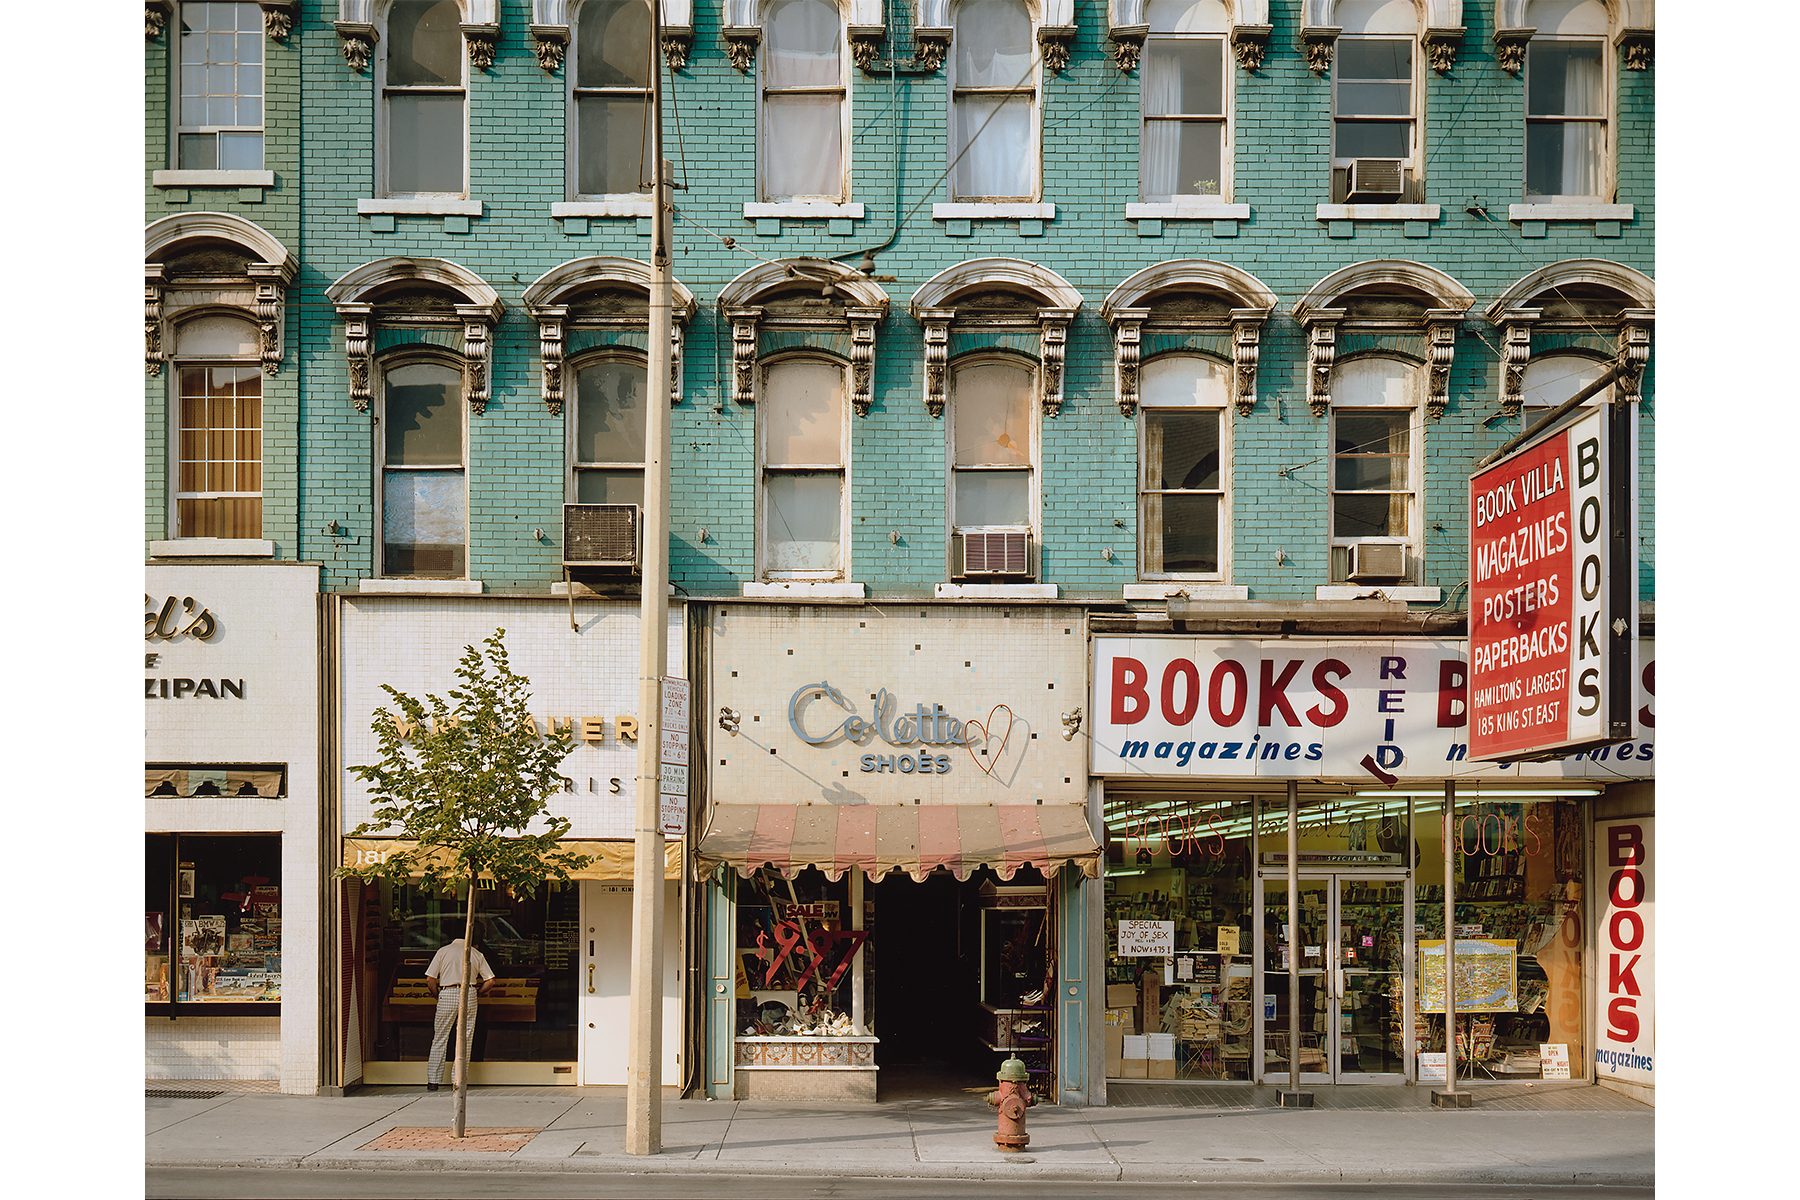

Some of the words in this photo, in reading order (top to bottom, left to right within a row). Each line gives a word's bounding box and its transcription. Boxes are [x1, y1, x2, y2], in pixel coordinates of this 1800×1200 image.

[1477, 480, 1517, 528] BOOK
[1521, 457, 1565, 507] VILLA
[1477, 511, 1567, 582] MAGAZINES
[1577, 437, 1600, 717] BOOKS
[1484, 573, 1559, 626] POSTERS
[1474, 621, 1567, 675] PAPERBACKS
[664, 691, 687, 701] LOADING
[1110, 656, 1352, 728] BOOKS
[1474, 677, 1522, 709] HAMILTON'S
[1526, 668, 1567, 697] LARGEST
[668, 700, 682, 708] ZONE
[788, 680, 978, 746] Colette
[1377, 656, 1407, 770] REID
[1478, 717, 1493, 736] 185
[1497, 710, 1518, 732] KING
[1521, 706, 1534, 728] ST.
[1536, 701, 1560, 723] EAST
[663, 741, 687, 752] STOPPING
[670, 733, 680, 742] NO
[1120, 734, 1323, 767] magazines
[664, 767, 671, 775] 30
[673, 768, 685, 776] MIN
[860, 754, 952, 774] SHOES
[663, 775, 685, 785] PARKING
[661, 805, 686, 815] STOPPING
[669, 797, 678, 806] NO
[1125, 813, 1224, 856] BOOKS
[357, 850, 385, 864] 181
[787, 904, 824, 917] SALE
[199, 920, 214, 928] BMW
[1129, 921, 1162, 929] SPECIAL
[1607, 824, 1646, 1043] BOOKS
[1121, 931, 1136, 939] JOY
[1139, 931, 1149, 939] OF
[1152, 931, 1168, 939] SEX
[1131, 945, 1150, 953] NOW
[1595, 1047, 1652, 1072] magazines
